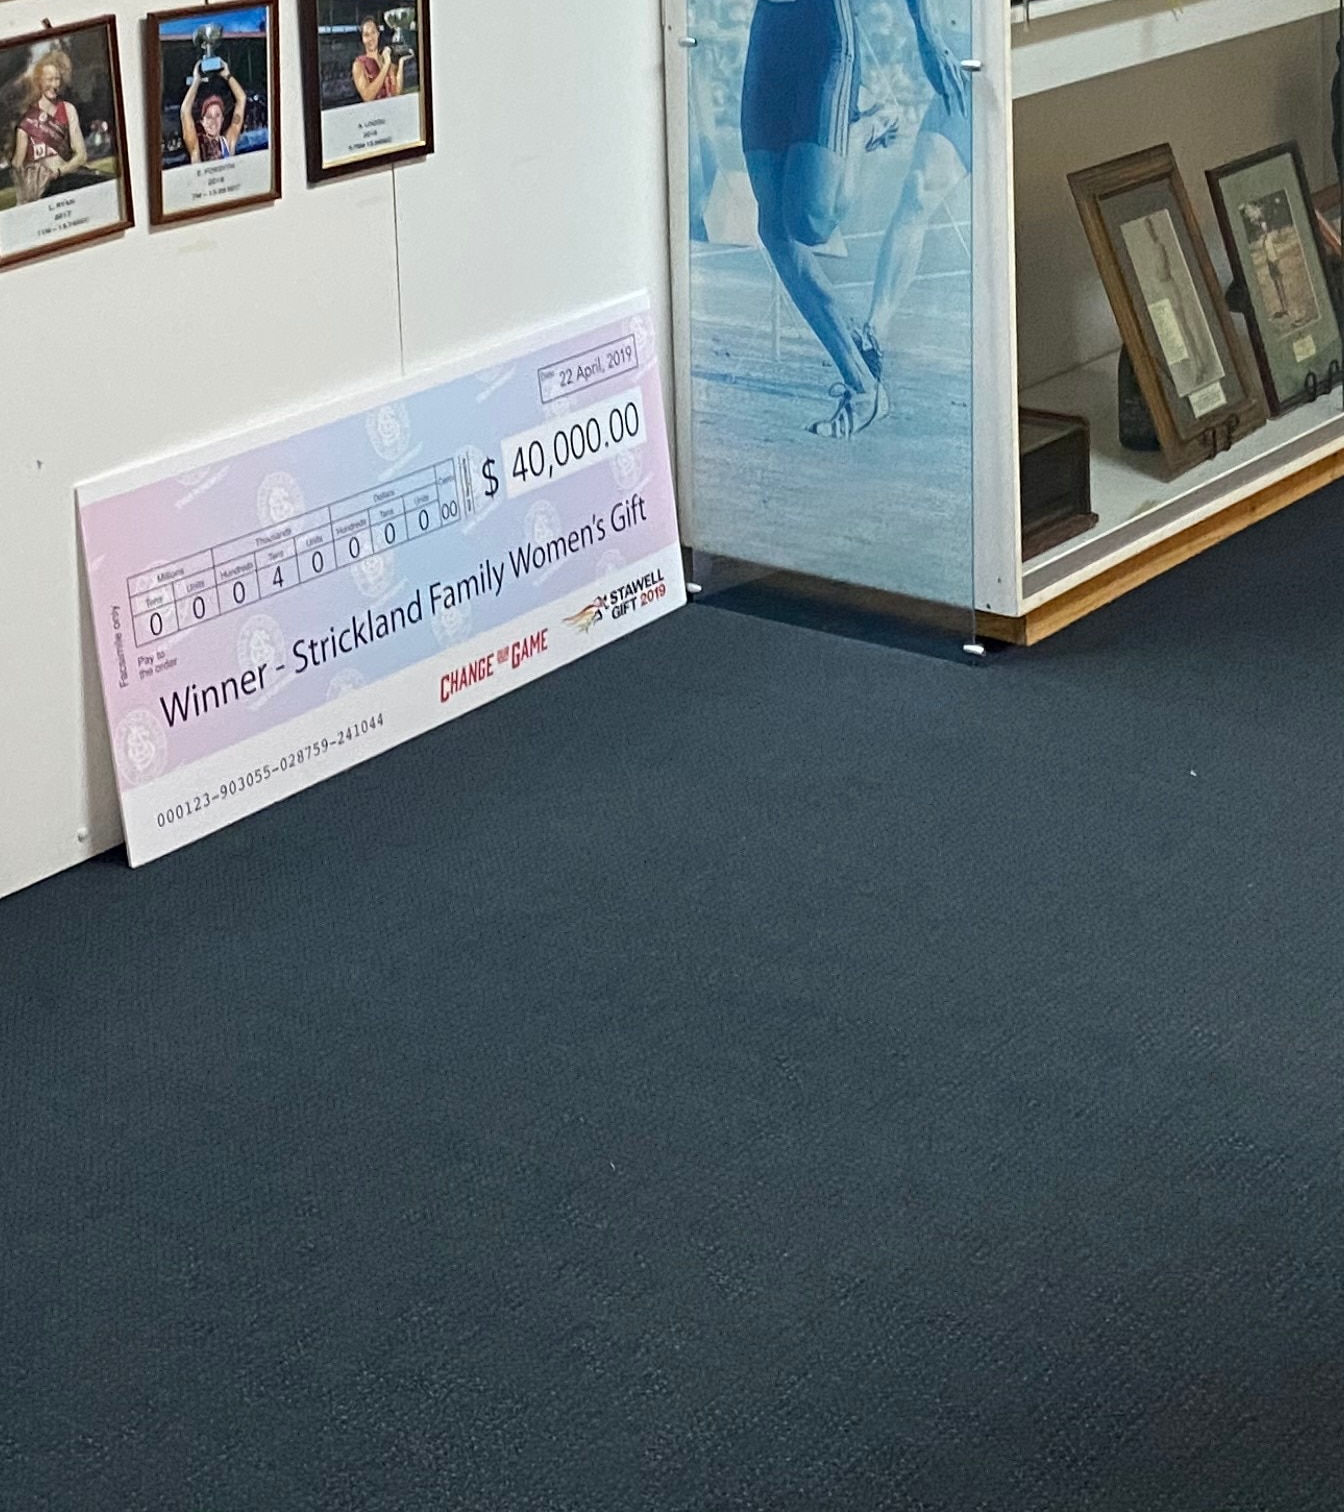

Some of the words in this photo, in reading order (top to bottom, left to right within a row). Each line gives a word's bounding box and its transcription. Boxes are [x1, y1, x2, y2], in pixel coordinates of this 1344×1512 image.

[558, 368, 574, 388] 22
[575, 356, 606, 383] April,
[607, 345, 633, 369] 2019
[481, 455, 500, 500] $
[511, 401, 640, 483] 40,000.00
[149, 612, 163, 636] 0
[192, 596, 206, 620] 0
[232, 580, 246, 605] 0
[271, 565, 285, 589] 4
[311, 550, 324, 574] 0
[348, 535, 361, 559] 0
[384, 522, 396, 545] 0
[418, 509, 430, 532] 0
[441, 499, 458, 521] 00
[609, 568, 665, 606] STAWELL
[611, 596, 638, 620] GIFT
[639, 583, 667, 608] 2019
[159, 661, 268, 728] Winner
[292, 587, 424, 674] Strickland
[429, 559, 505, 615] Family
[508, 513, 606, 579] Women's
[610, 493, 648, 533] Gift
[137, 654, 154, 668] Pay
[440, 652, 495, 703] CHANGE
[511, 627, 549, 669] GAME
[156, 712, 385, 828] 000123-903055-028759-241044
